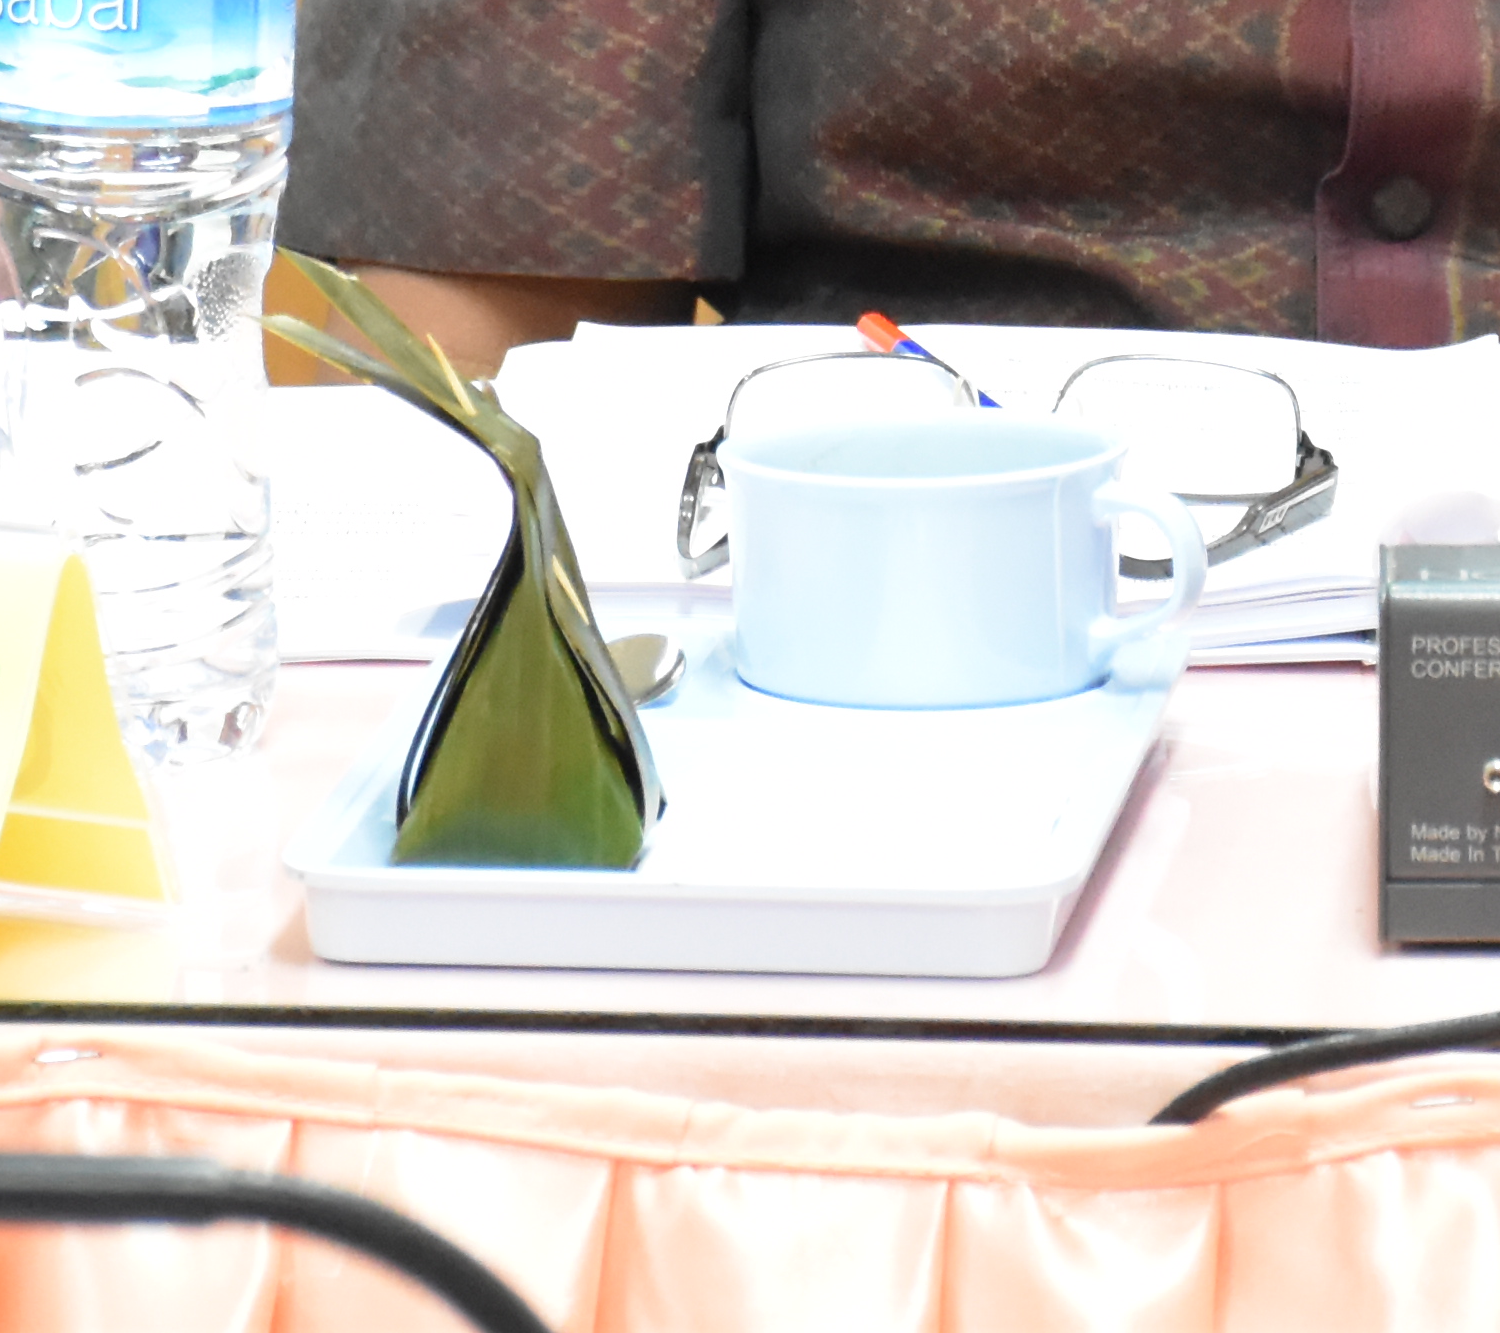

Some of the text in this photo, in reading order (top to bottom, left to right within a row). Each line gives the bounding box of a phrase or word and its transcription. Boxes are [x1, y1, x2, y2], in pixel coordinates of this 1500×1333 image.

[1411, 824, 1460, 840] Made
[1467, 824, 1488, 843] by
[1411, 847, 1460, 863] Made
